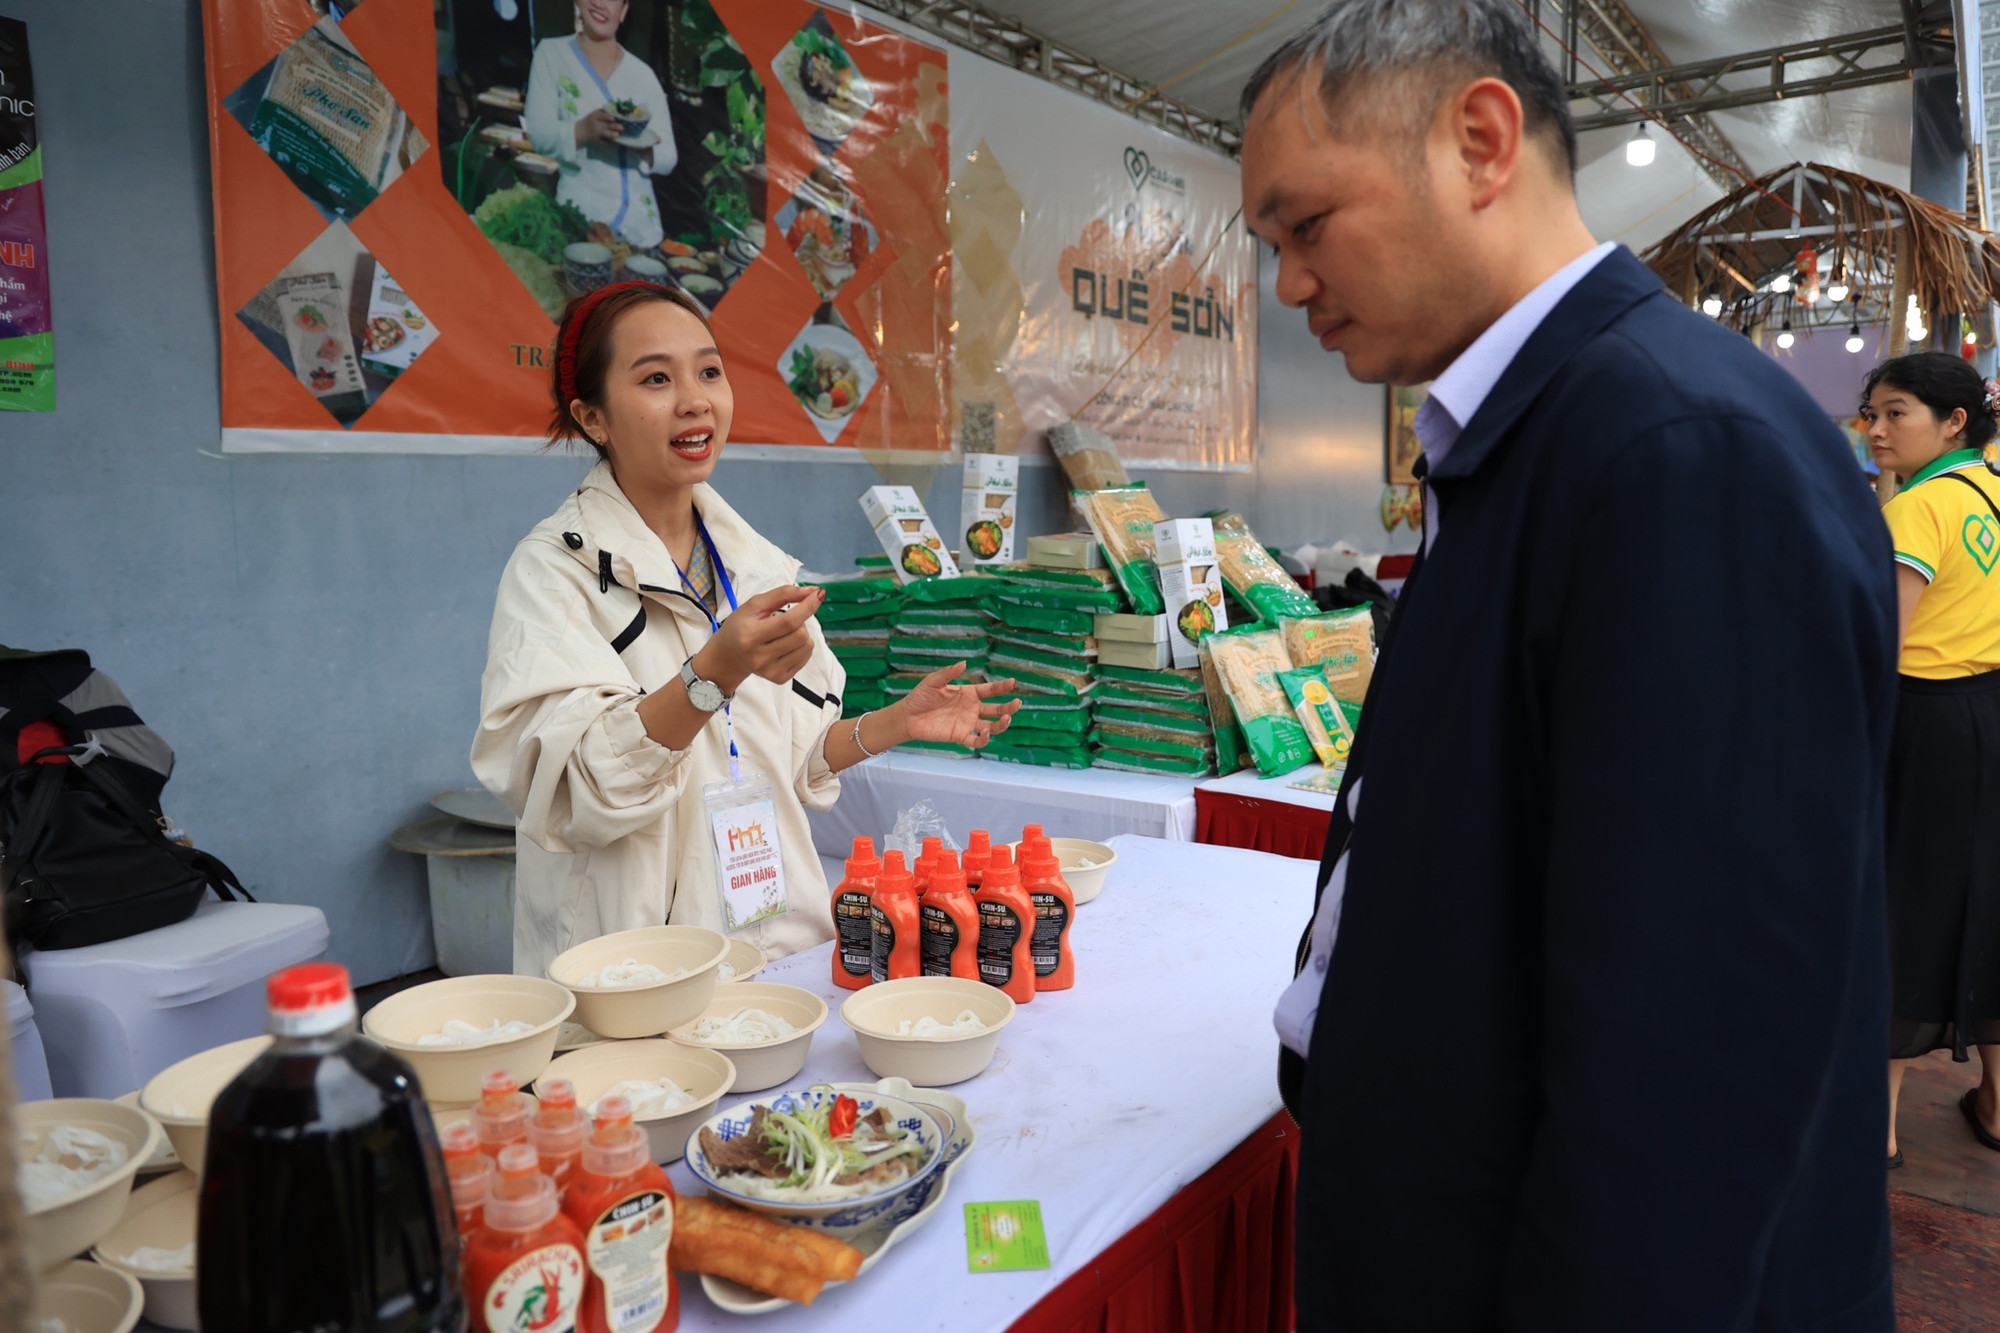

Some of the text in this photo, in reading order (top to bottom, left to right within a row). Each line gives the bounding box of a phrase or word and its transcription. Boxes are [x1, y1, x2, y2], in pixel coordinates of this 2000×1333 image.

[731, 865, 777, 890] GIAN HÀNG
[843, 893, 869, 904] CHIN-SU
[1030, 895, 1055, 903] HIN-SU
[980, 903, 1006, 913] CHIN-SU
[612, 1194, 655, 1220] CHIN-SU
